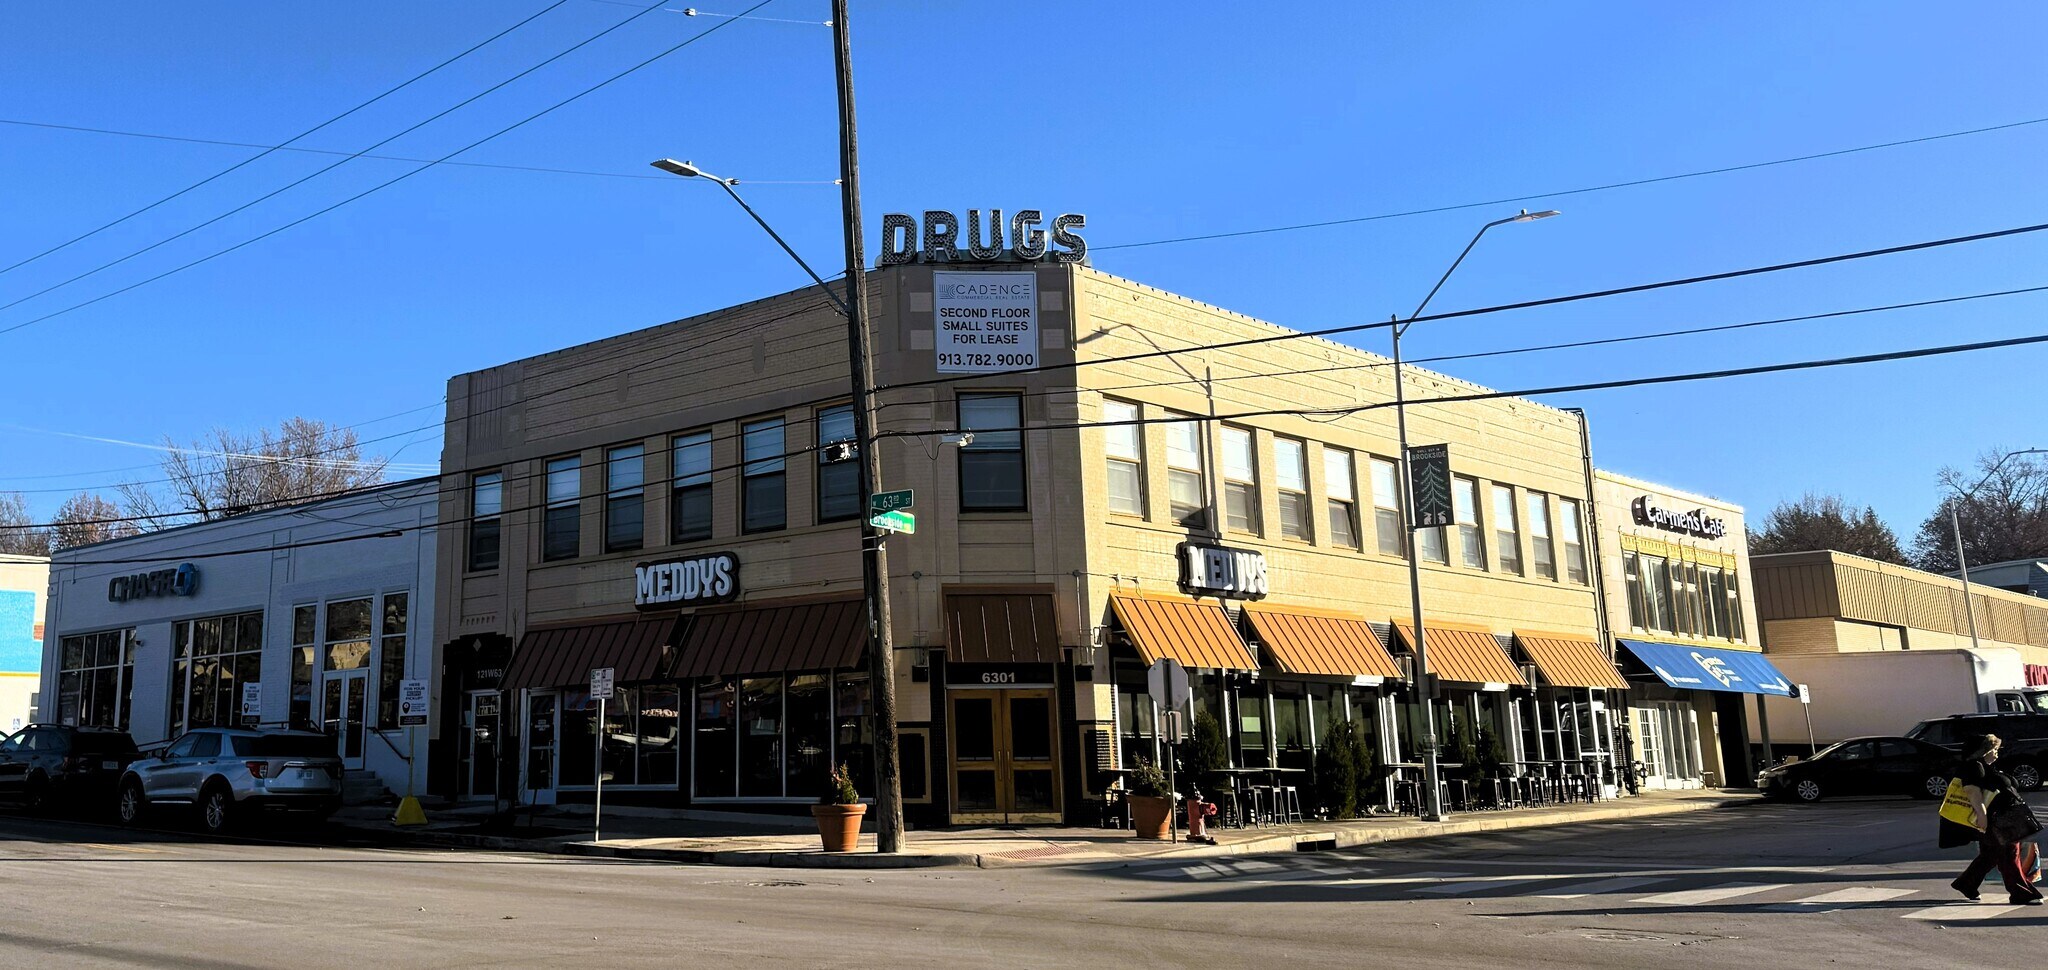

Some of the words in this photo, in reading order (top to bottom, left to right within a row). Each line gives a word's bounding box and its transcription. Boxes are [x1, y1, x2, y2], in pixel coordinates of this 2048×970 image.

[882, 208, 1088, 264] DRUGS
[955, 284, 1030, 295] CADENCE
[940, 308, 988, 318] SECOND
[991, 308, 1031, 318] FLOOR
[942, 321, 982, 331] SMALL
[986, 321, 1029, 331] SUITES
[953, 334, 977, 344] FOR
[980, 334, 1019, 344] LEASE
[938, 353, 1034, 366] 913.782.9000
[1411, 450, 1446, 461] BROOKSIDE
[1645, 494, 1701, 532] Carmen's
[1187, 545, 1268, 595] MEDDYS
[634, 555, 732, 606] MEDDYS
[982, 672, 1015, 683] 6301
